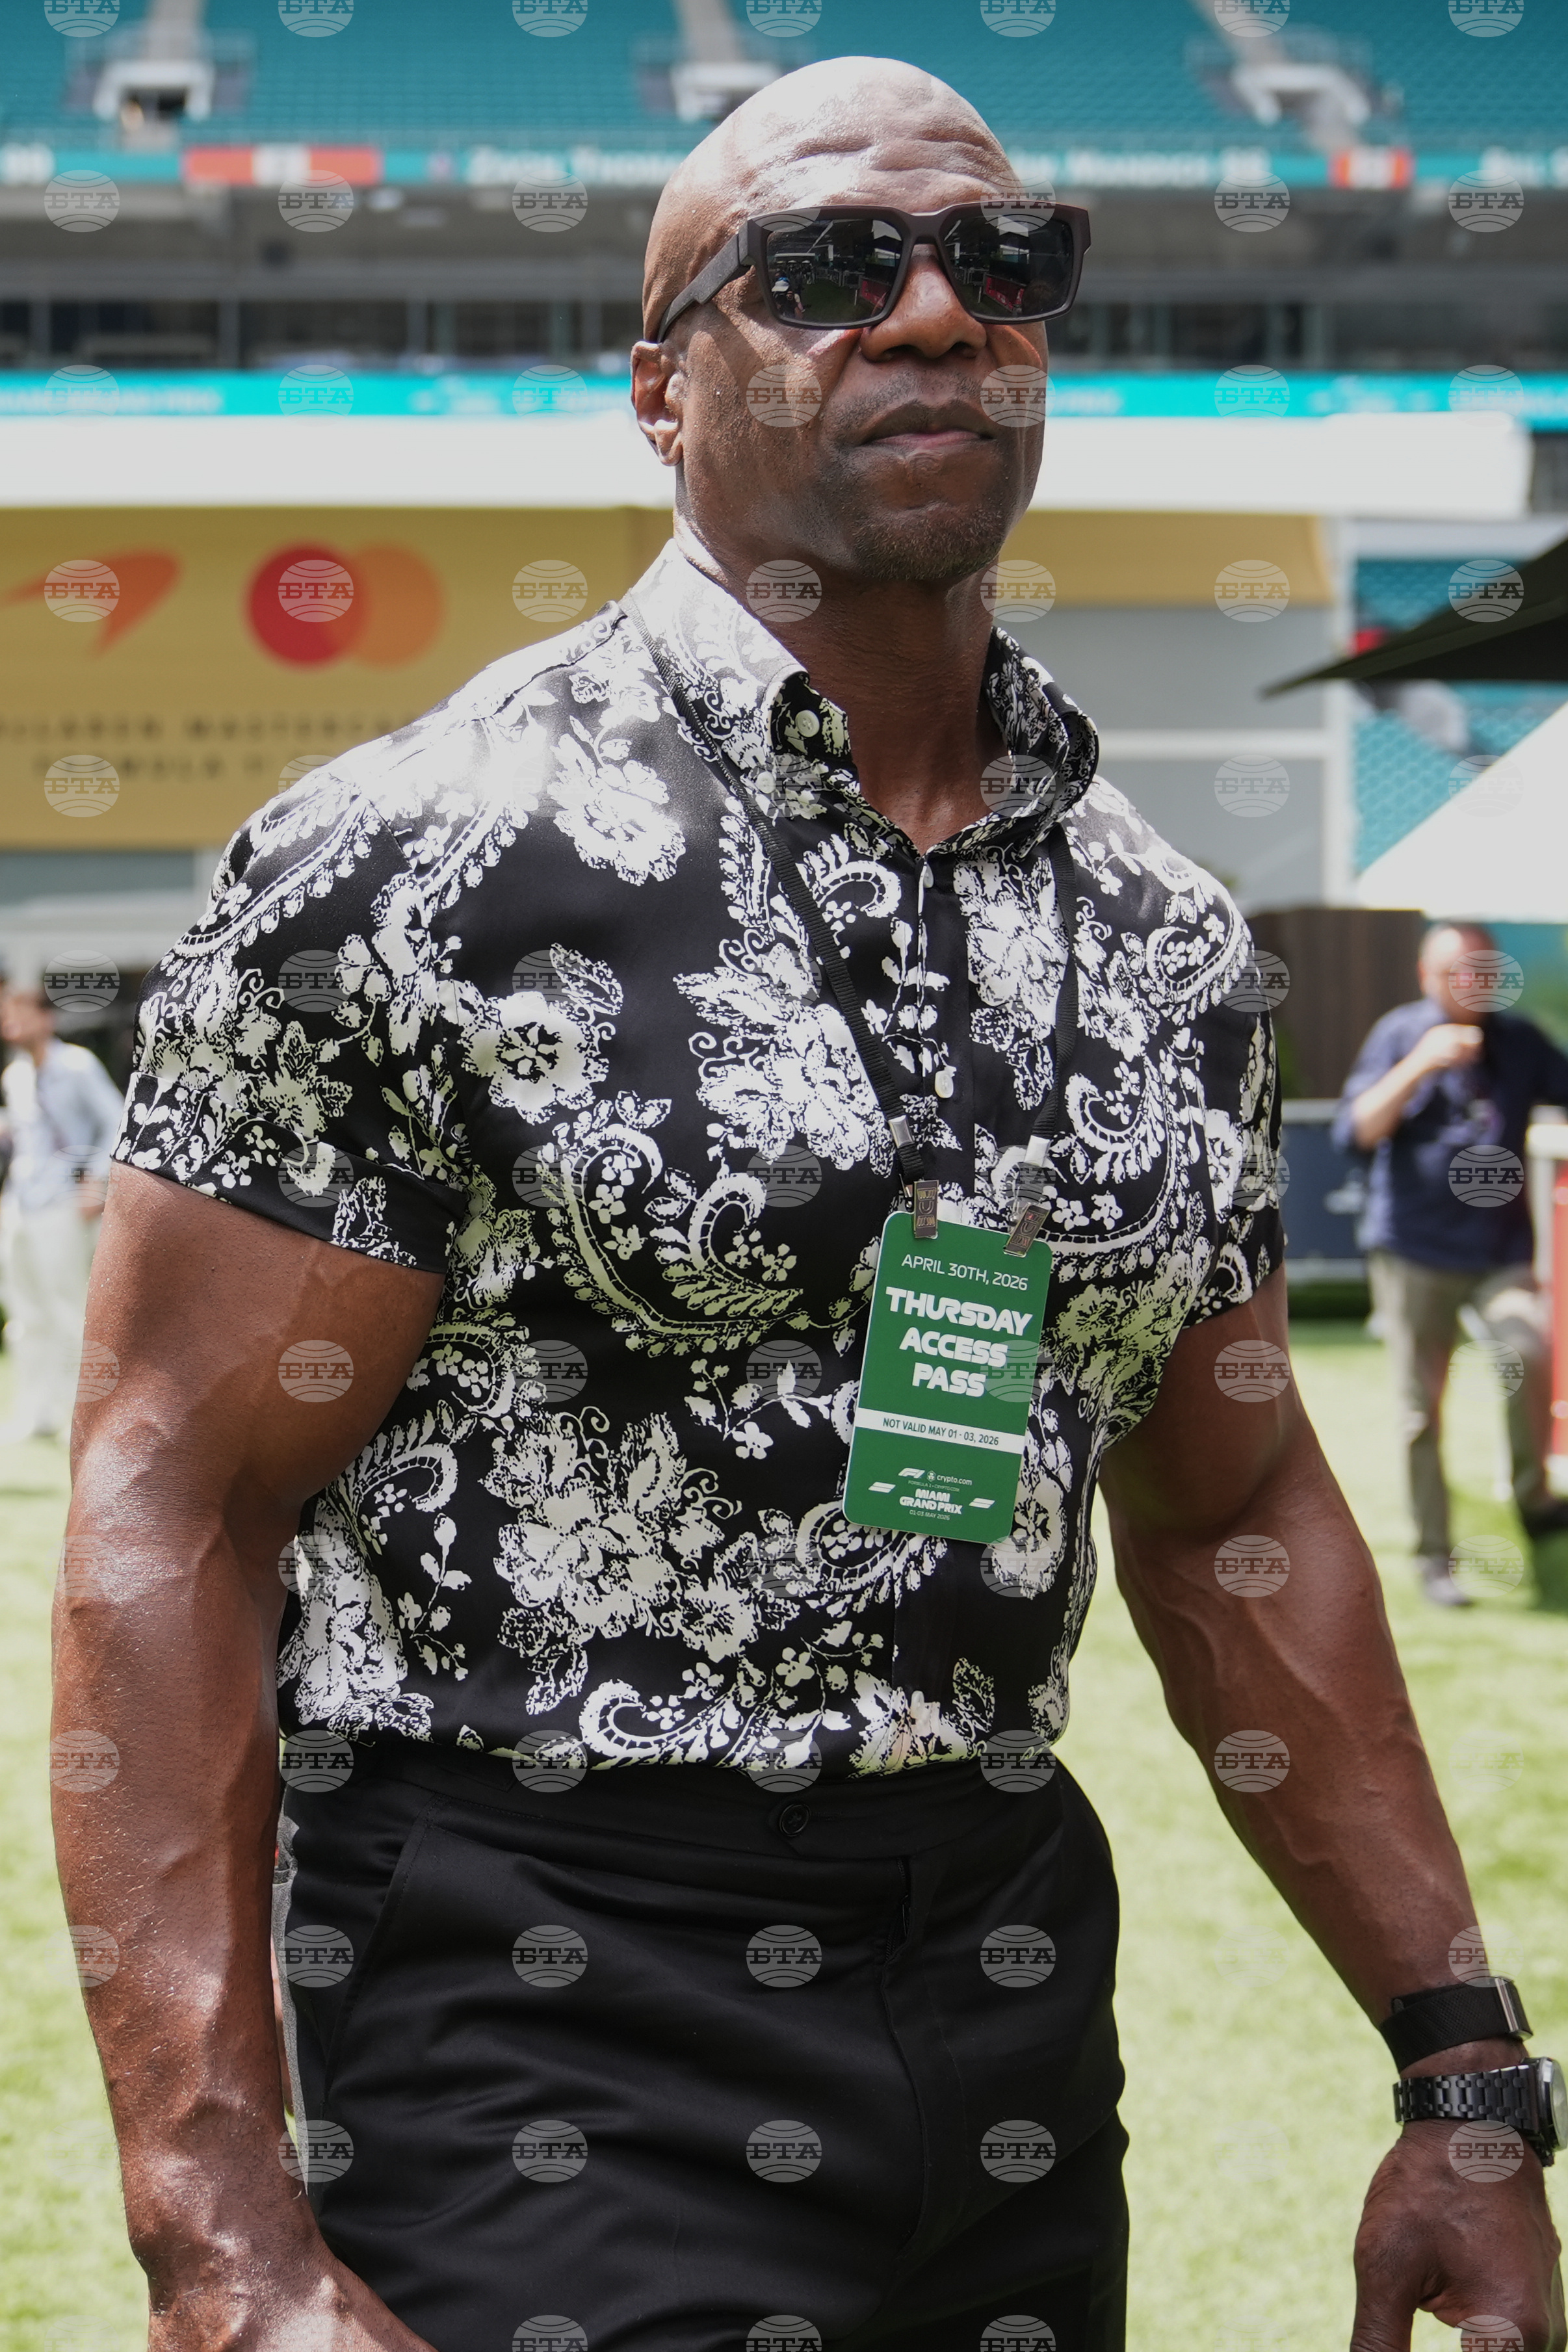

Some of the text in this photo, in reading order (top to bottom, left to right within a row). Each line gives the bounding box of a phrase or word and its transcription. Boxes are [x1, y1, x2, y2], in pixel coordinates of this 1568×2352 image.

[901, 1254, 1028, 1291] APRIL 30TH, 2026
[885, 1286, 1033, 1336] THURSDAY
[899, 1327, 1008, 1368] ACCESS
[912, 1362, 986, 1397] PASS
[883, 1417, 900, 1429] NOT
[902, 1420, 926, 1433] VALID
[928, 1425, 946, 1437] MAY
[948, 1429, 958, 1439] 01
[963, 1431, 976, 1443] 03,
[978, 1434, 999, 1446] 2026
[898, 1467, 926, 1479] F1
[937, 1474, 973, 1485] crypto.com
[899, 1496, 963, 1515] GRAND PRIX
[915, 1488, 950, 1502] MIAMI
